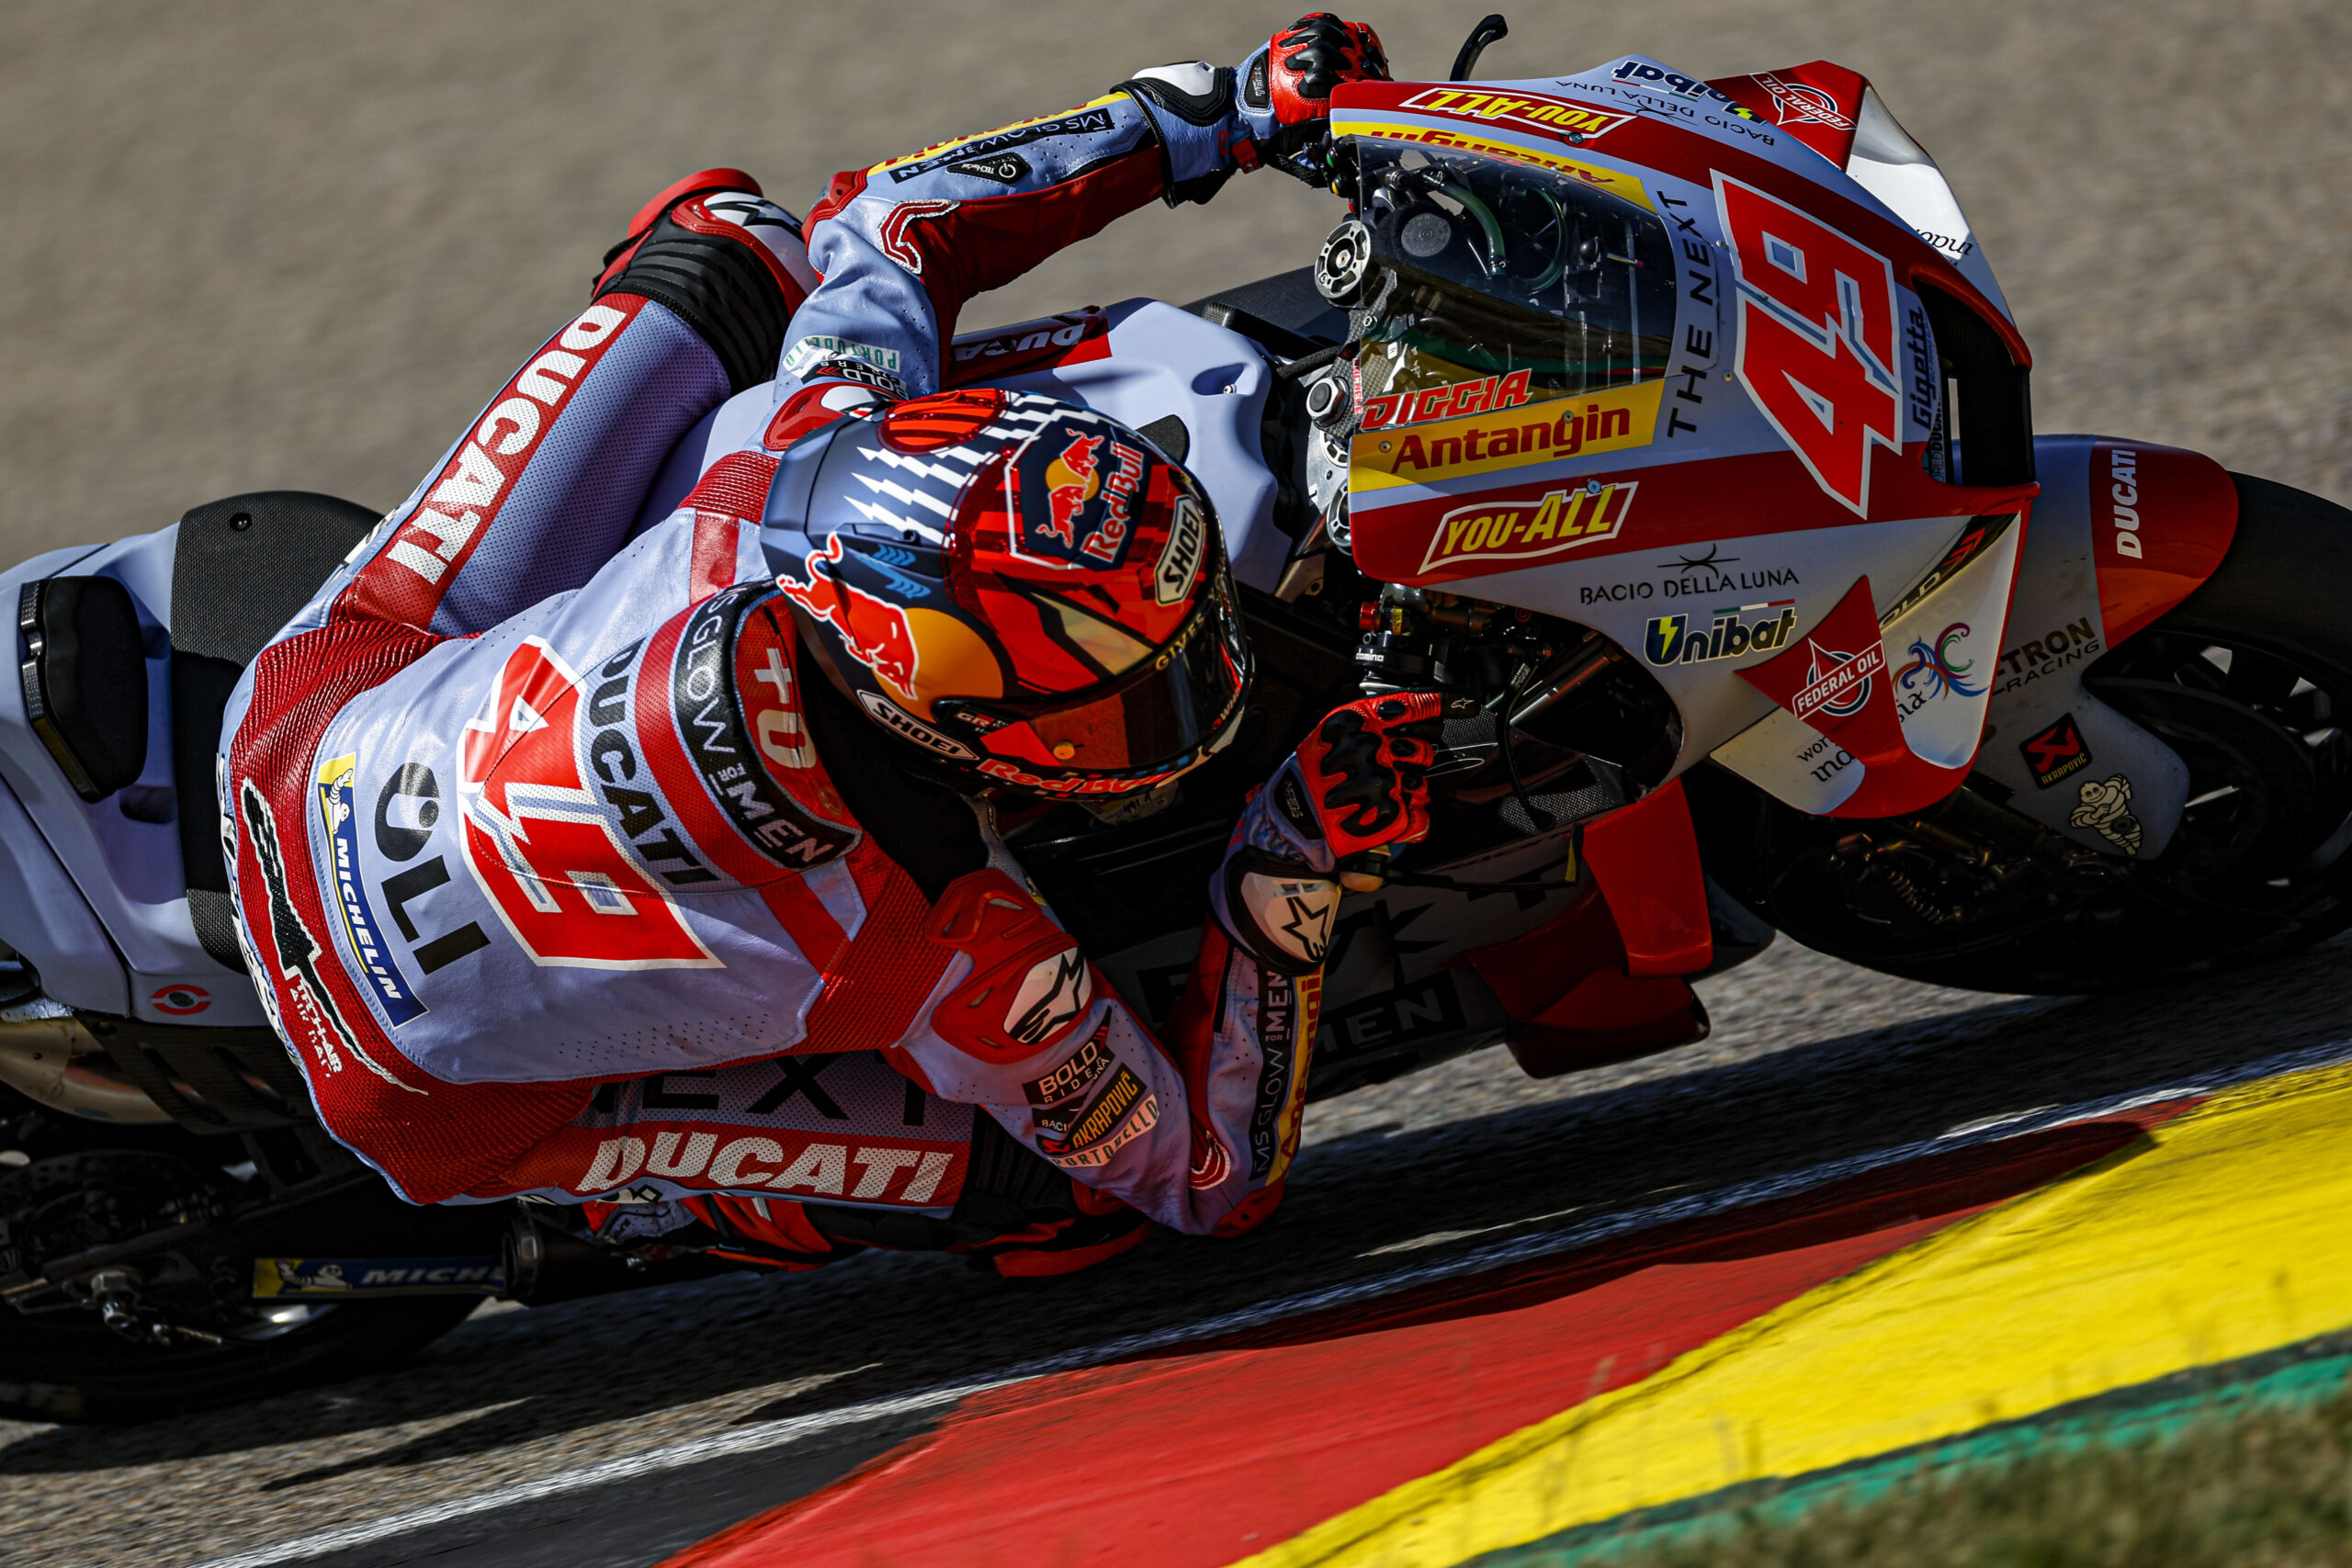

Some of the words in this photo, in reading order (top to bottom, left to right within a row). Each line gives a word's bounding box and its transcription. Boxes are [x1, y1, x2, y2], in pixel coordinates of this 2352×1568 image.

[1425, 91, 1609, 131] YOU-ALL
[1555, 80, 1616, 96] LUNA
[1622, 91, 1693, 117] DELLA
[1763, 75, 1787, 96] OIL
[1786, 92, 1854, 129] FEDERAL
[1065, 113, 1105, 130] MS
[1705, 116, 1775, 146] BACIO
[1657, 191, 1713, 306] NEXT
[955, 323, 1086, 360] DUCA
[1710, 168, 1902, 521] 49
[1908, 306, 1937, 431] Gigetta
[1360, 368, 1532, 431] DIGGIA
[1668, 324, 1712, 437] THE
[385, 305, 628, 585] DUCATI
[1390, 404, 1630, 473] Antangin
[1442, 485, 1616, 556] YOU-ALL
[2110, 449, 2143, 559] DUCATI
[1159, 505, 1201, 595] SHOEI
[1580, 581, 1654, 605] BACIO
[1664, 574, 1736, 598] DELLA
[1741, 568, 1800, 590] LUNA
[1881, 570, 1942, 627] OLD
[1644, 607, 1797, 667] Unibat
[2007, 639, 2100, 694] RACING
[686, 618, 735, 754] GLOW
[1796, 669, 1855, 713] FEDERAL
[1854, 650, 1882, 677] OIL
[876, 701, 962, 759] SHOEI
[589, 644, 721, 886] DUCATI
[717, 763, 747, 784] FOR
[456, 634, 727, 971] 49
[727, 780, 834, 863] MEN
[336, 837, 403, 999] MICHELIN
[1265, 970, 1288, 1034] MEN
[1038, 1041, 1101, 1096] BOLD
[1258, 1047, 1284, 1127] GLOW
[575, 1131, 954, 1202] DUCATI
[1255, 1134, 1272, 1172] MS
[362, 1266, 504, 1285] MICH
